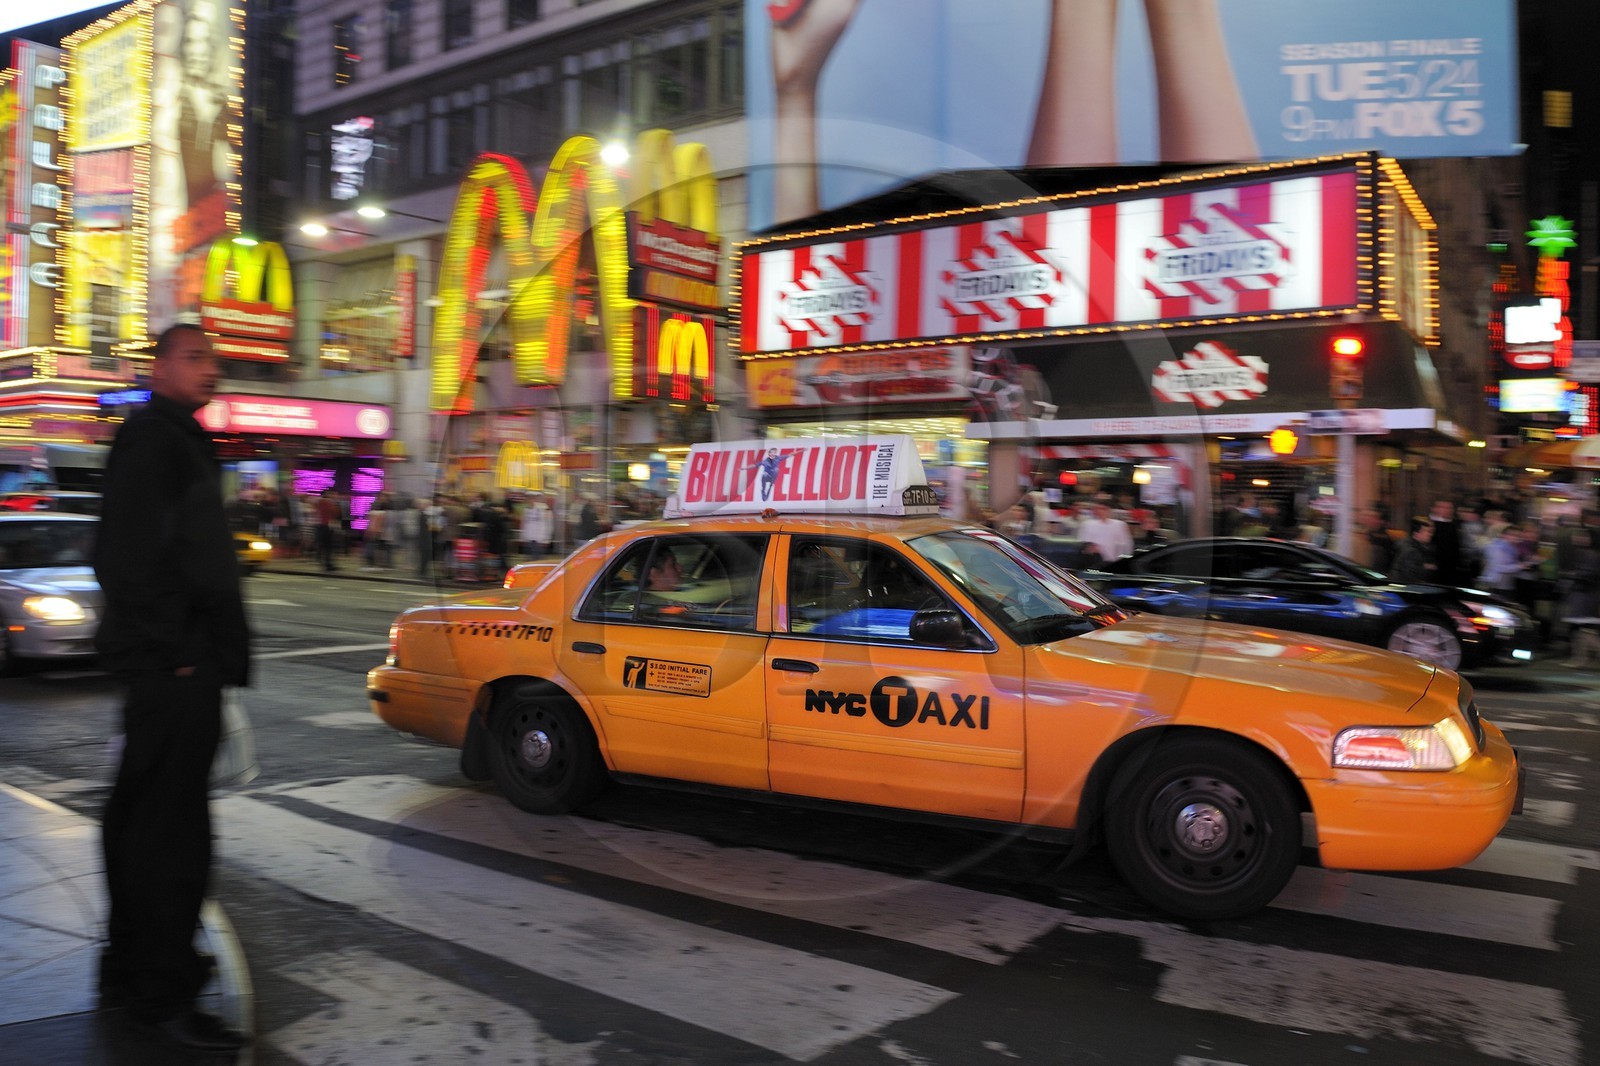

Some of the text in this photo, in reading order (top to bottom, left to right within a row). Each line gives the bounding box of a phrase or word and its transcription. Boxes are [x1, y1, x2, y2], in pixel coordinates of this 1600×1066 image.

[1280, 38, 1483, 60] SEASON FINALE
[1281, 60, 1484, 101] TUE 5/24
[1354, 101, 1446, 138] FOX
[685, 444, 877, 502] BILLY ELLIOT
[873, 443, 895, 499] THE MUSICAL
[911, 489, 929, 504] 7F10
[517, 625, 554, 643] 7F10
[668, 665, 689, 673] INITIAL
[692, 667, 707, 676] FARE
[805, 688, 867, 718] NYC
